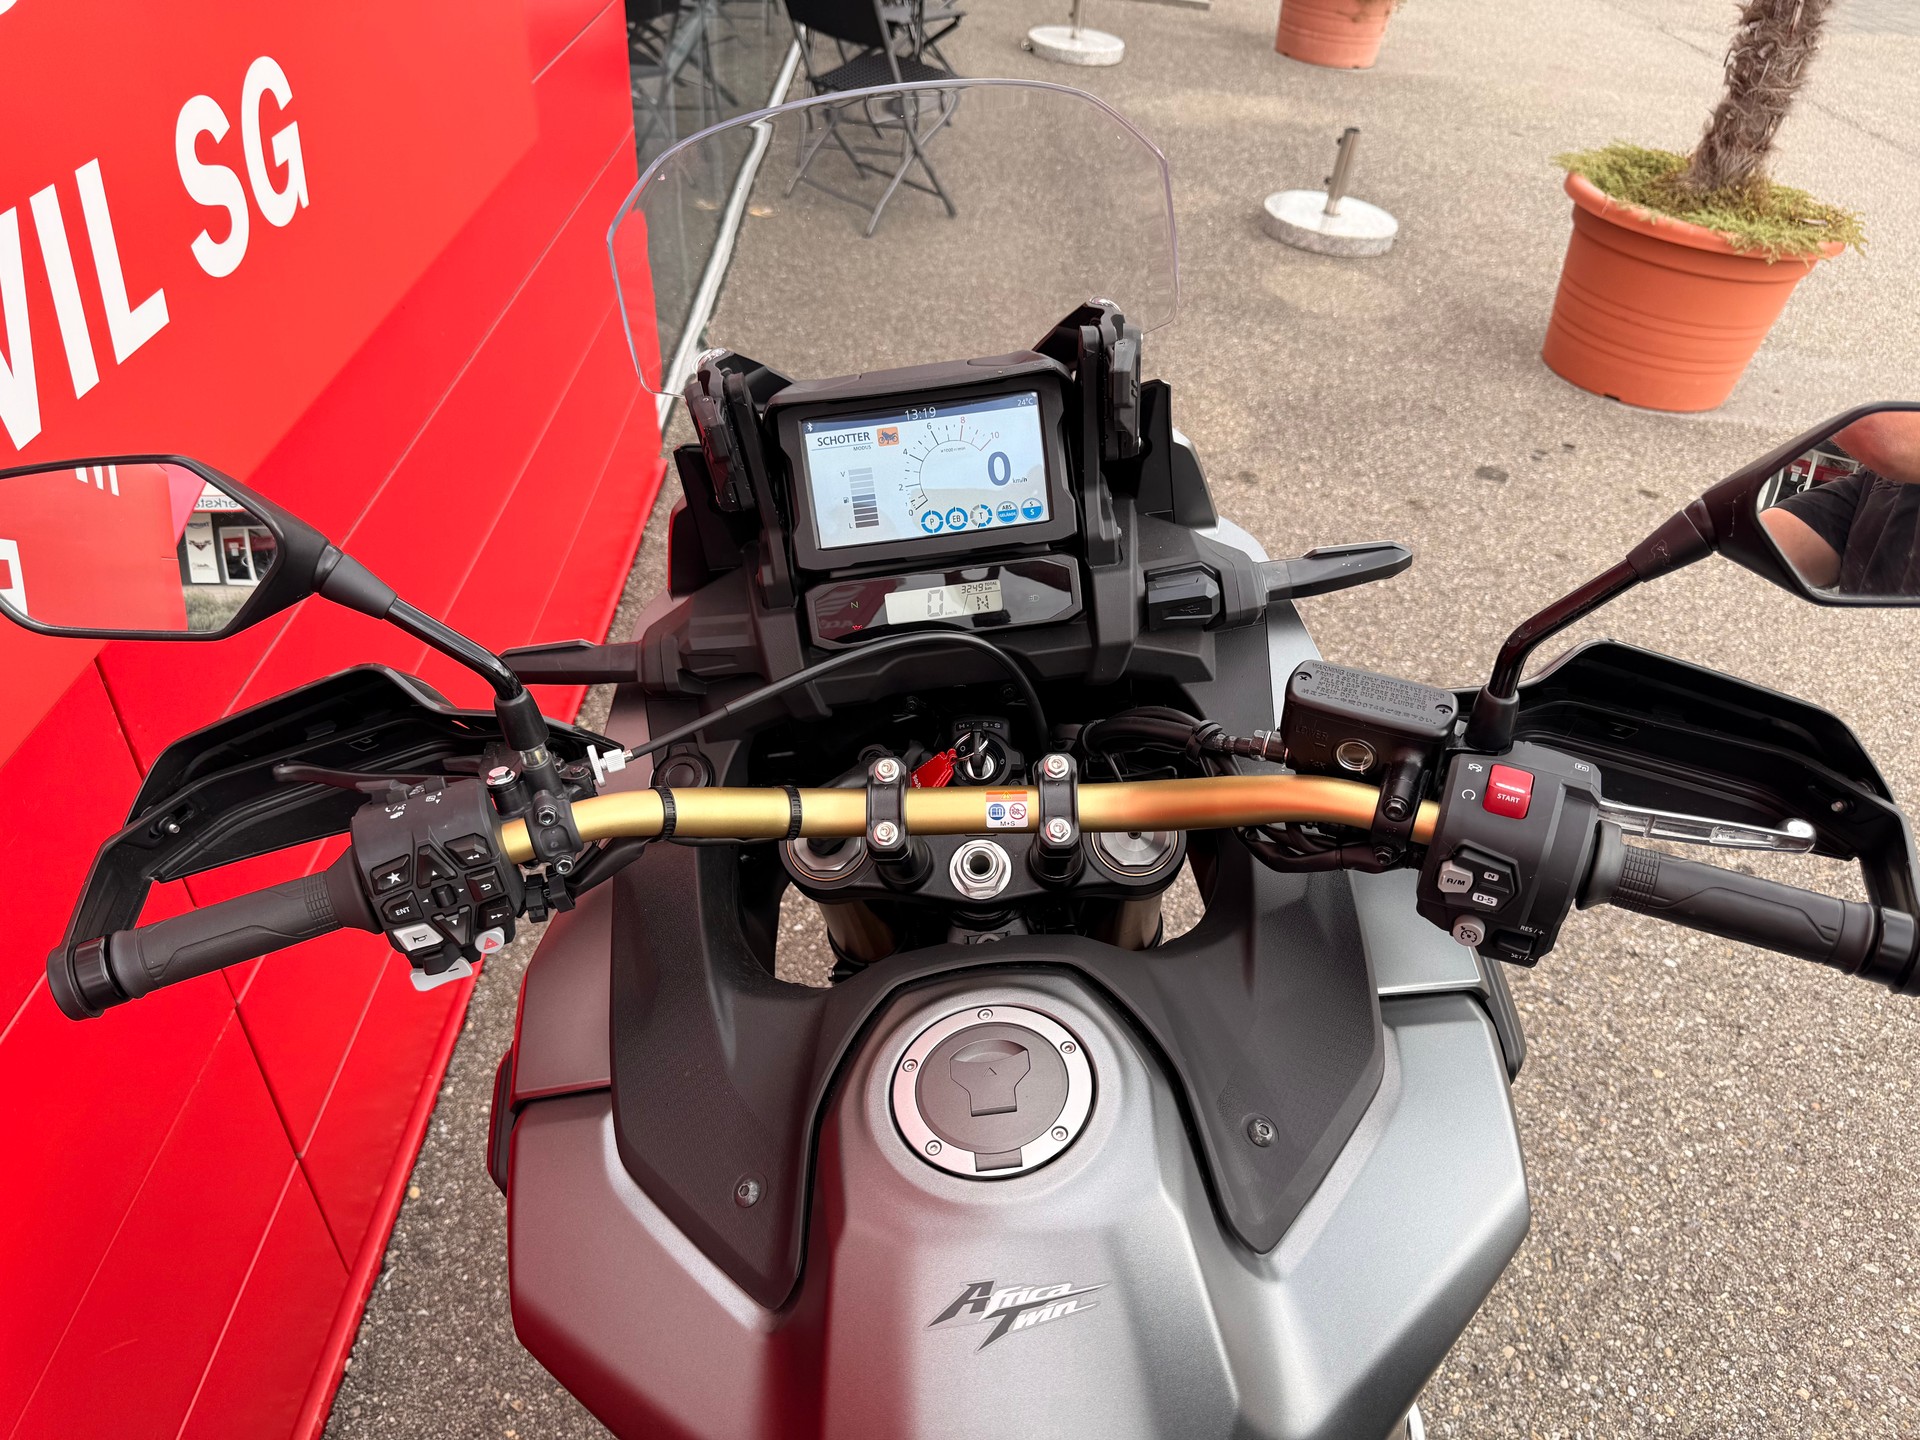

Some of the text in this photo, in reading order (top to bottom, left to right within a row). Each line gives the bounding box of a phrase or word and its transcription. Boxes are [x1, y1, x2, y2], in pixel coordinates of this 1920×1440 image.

[175, 56, 309, 278] SG
[904, 398, 1033, 421] 13:19 24°C
[926, 422, 932, 430] 6
[960, 416, 966, 424] 8
[817, 431, 871, 447] SCHOTTER
[990, 431, 1000, 439] 10
[902, 448, 908, 456] 4
[987, 451, 1011, 486] 0
[1030, 508, 1035, 516] S
[961, 583, 984, 594] 3249
[927, 589, 944, 618] 0
[976, 595, 990, 611] N
[1312, 663, 1344, 675] WARNING
[1399, 683, 1422, 693] BRAKE
[1315, 669, 1335, 678] FROM
[1341, 676, 1369, 686] SEALED
[1319, 676, 1344, 686] FILLER
[1360, 686, 1388, 696] BEFORE
[1496, 793, 1520, 804] START
[1446, 878, 1466, 886] A/M
[1476, 894, 1495, 905] D-S
[395, 906, 411, 917] ENT
[928, 1280, 1111, 1327] Africa
[977, 1300, 1097, 1352] Twin
